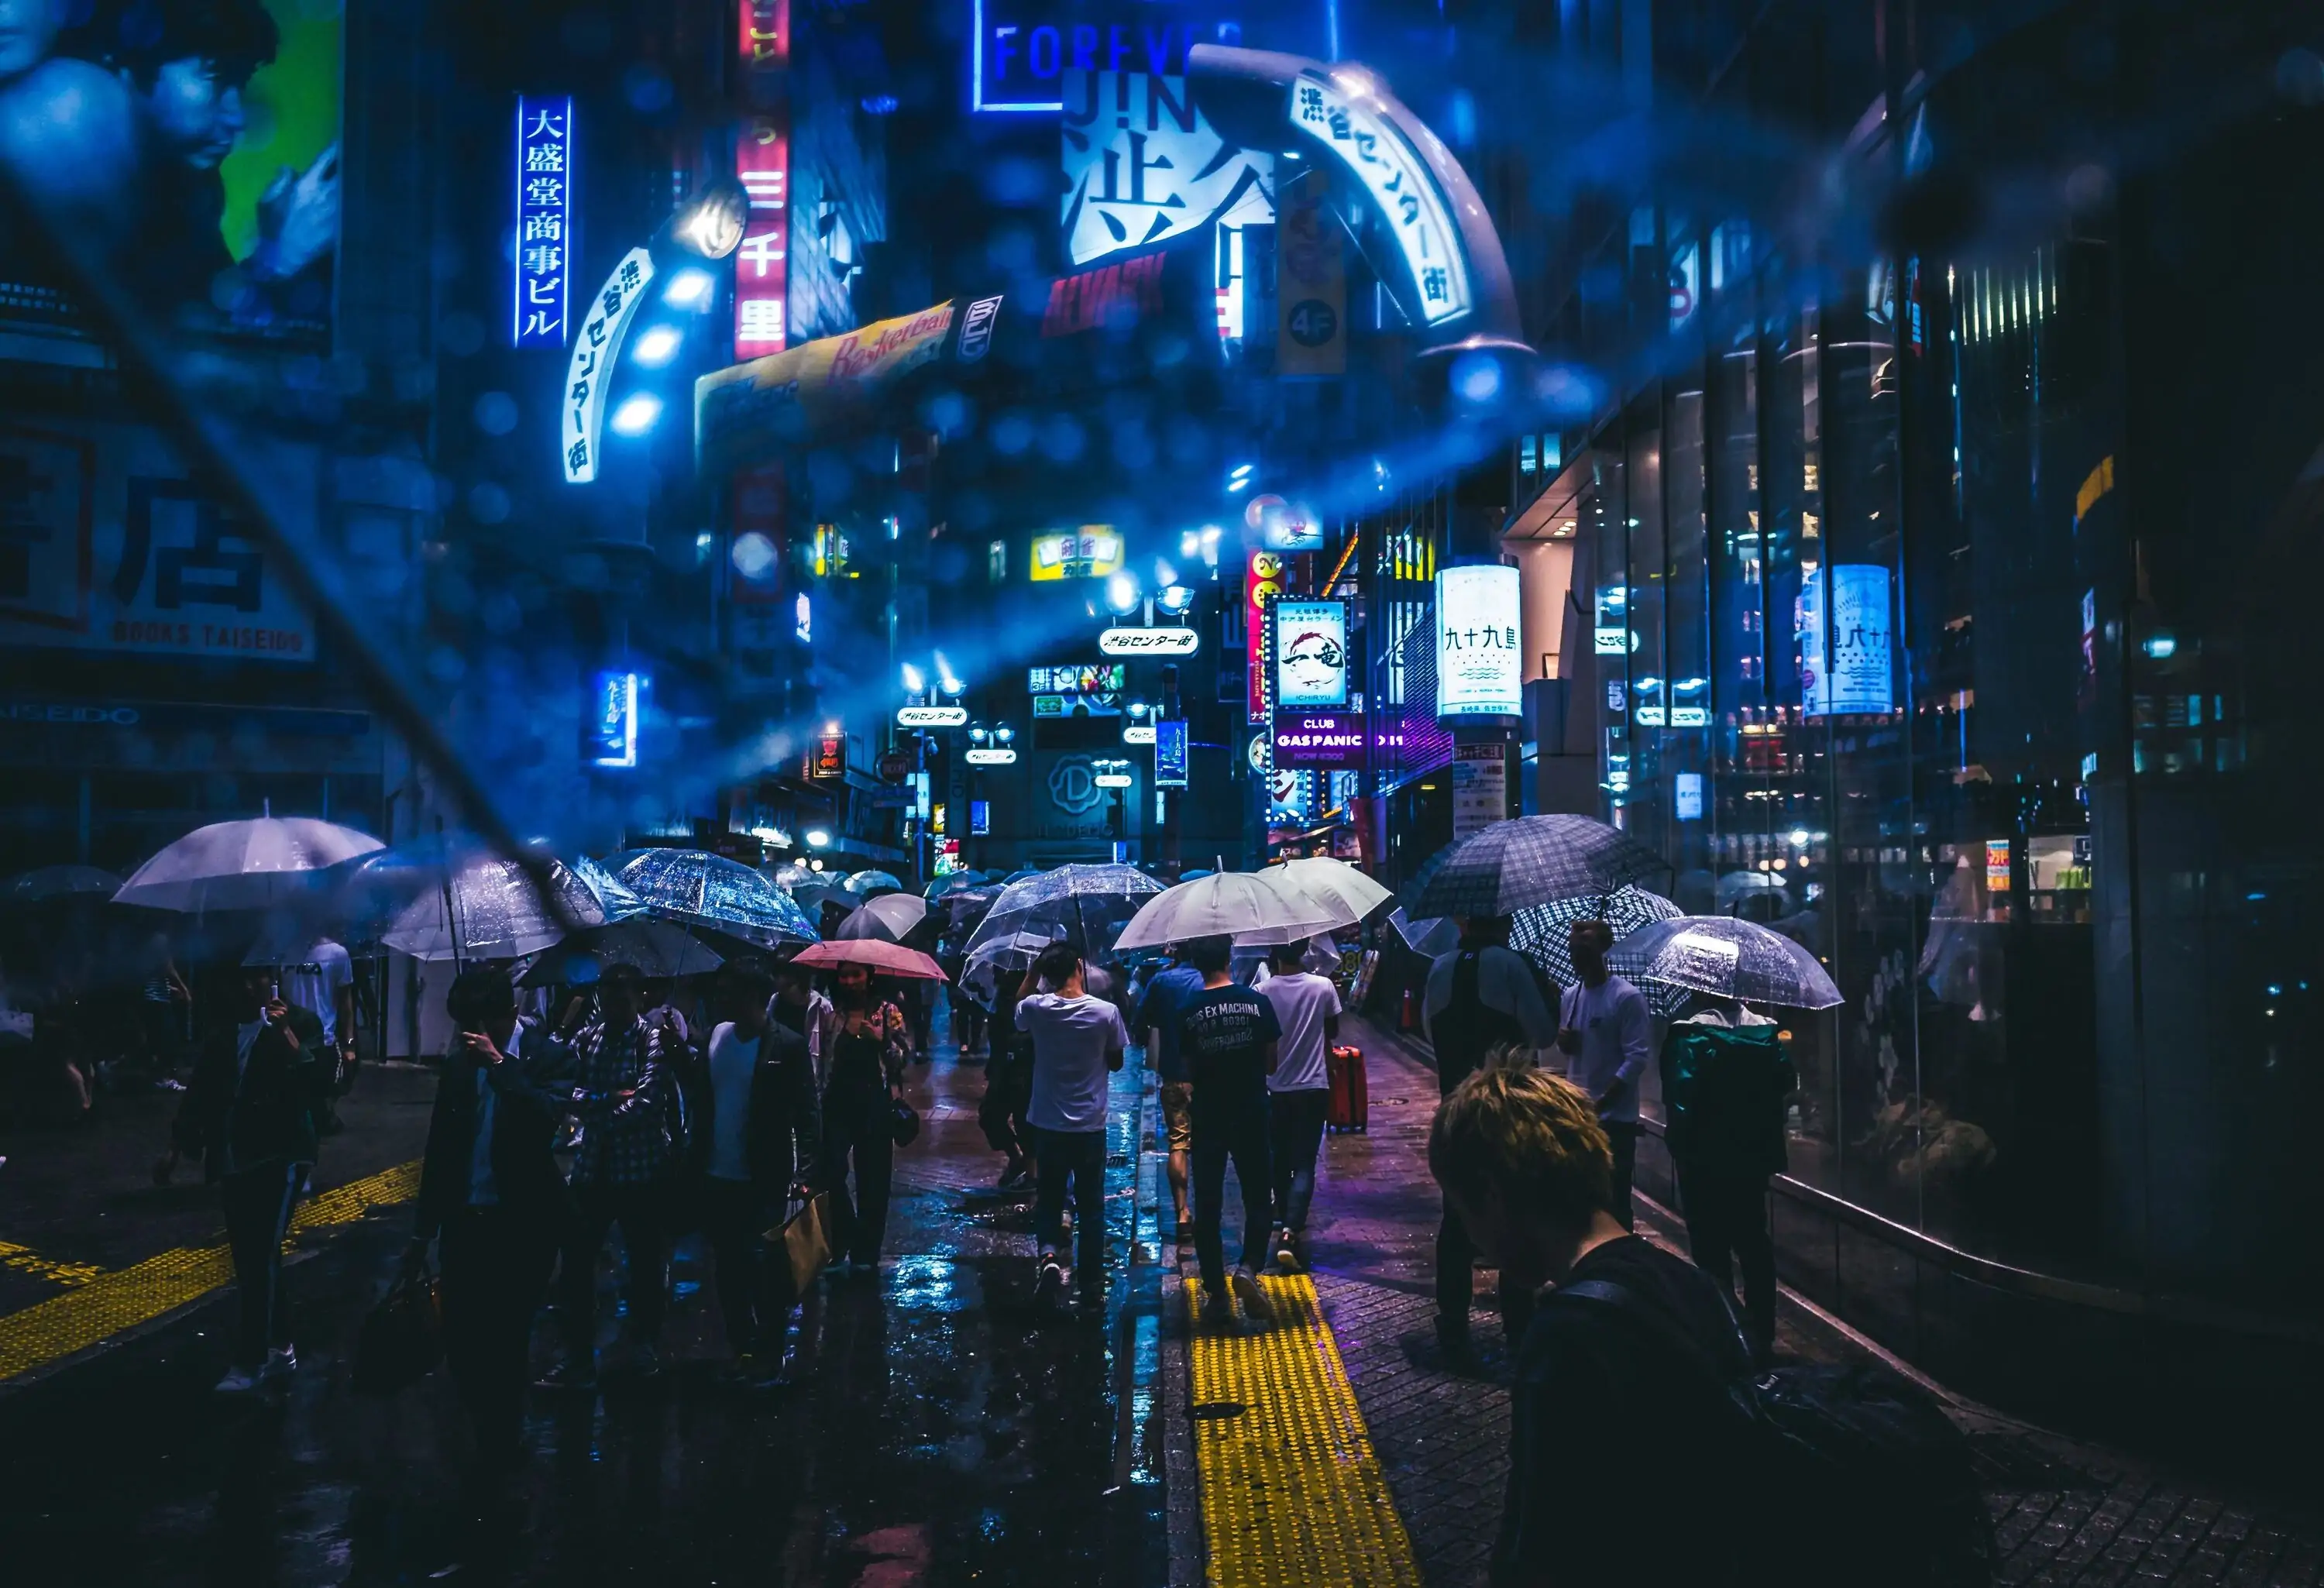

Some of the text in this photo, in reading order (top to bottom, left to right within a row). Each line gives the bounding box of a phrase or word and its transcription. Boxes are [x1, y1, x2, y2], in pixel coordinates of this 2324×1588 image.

[523, 109, 563, 336] 大盛堂商事ビル
[739, 170, 785, 342] 三千里
[569, 260, 641, 476] 渋谷センター街
[1104, 635, 1195, 647] 渋谷センター街
[1446, 625, 1516, 650] 九十九島
[1281, 642, 1344, 668] 一竜
[1303, 719, 1336, 729] CLUB
[1219, 1002, 1260, 1017] MACHINA
